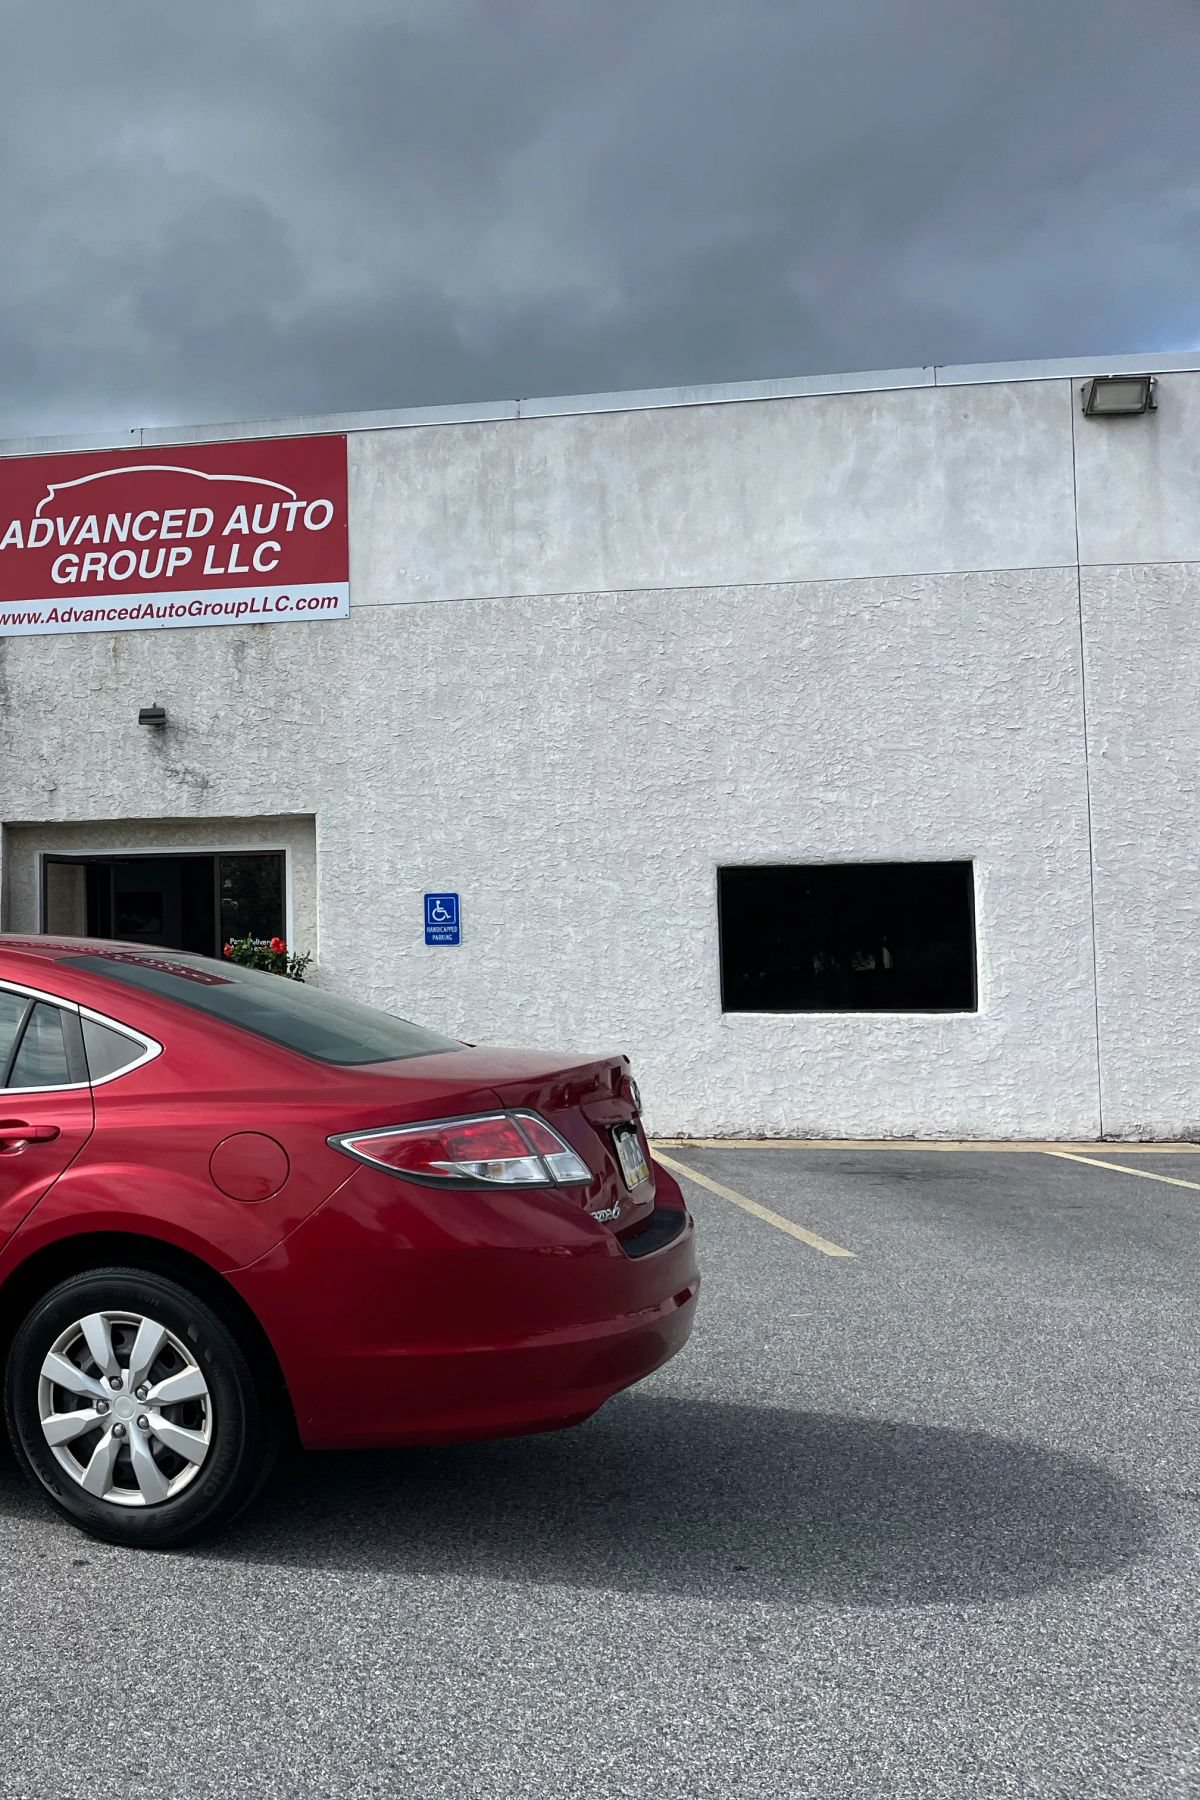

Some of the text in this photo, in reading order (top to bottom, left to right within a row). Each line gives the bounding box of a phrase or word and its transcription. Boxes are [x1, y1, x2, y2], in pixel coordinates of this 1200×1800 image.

[222, 499, 334, 536] AUTO
[51, 540, 281, 584] GROUP LLC
[432, 934, 453, 942] PARKING
